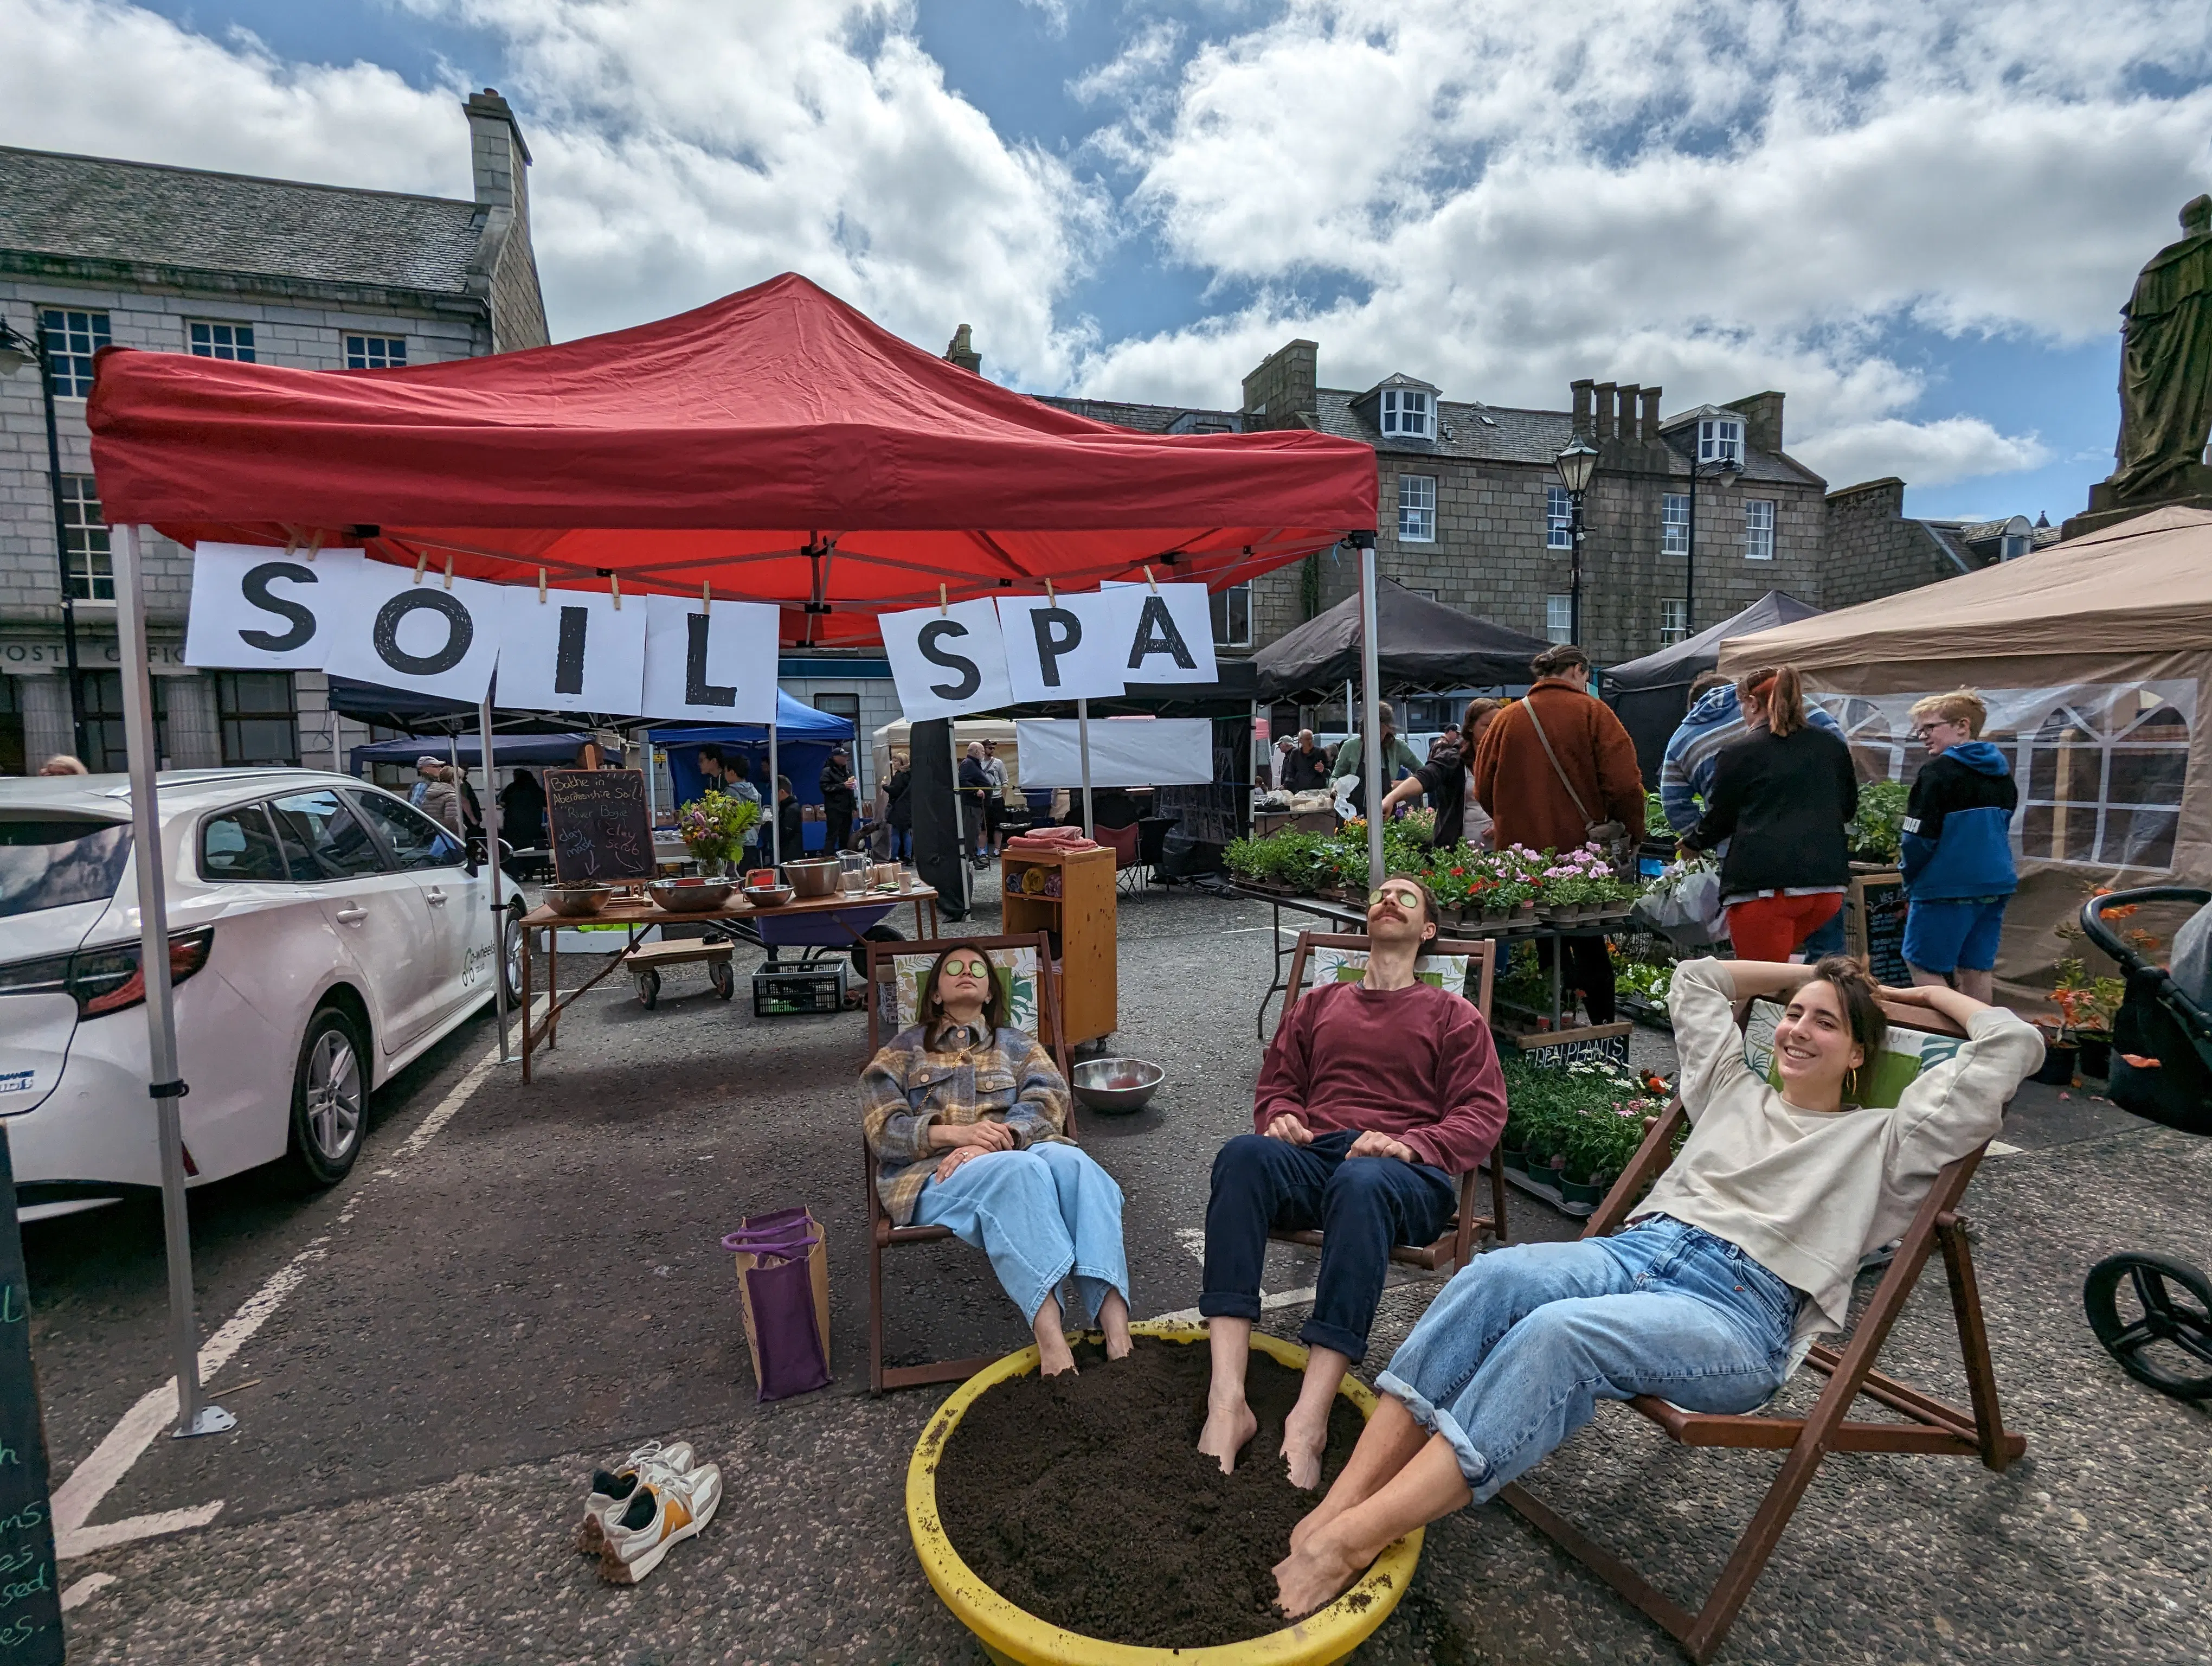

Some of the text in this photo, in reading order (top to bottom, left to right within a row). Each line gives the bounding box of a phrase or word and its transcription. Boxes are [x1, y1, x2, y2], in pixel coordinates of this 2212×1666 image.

[239, 562, 1198, 707] SOIL SPA
[0, 645, 63, 662] OST
[550, 774, 605, 791] Bathe in
[568, 807, 593, 818] River
[1566, 1035, 1624, 1065] PLANTS
